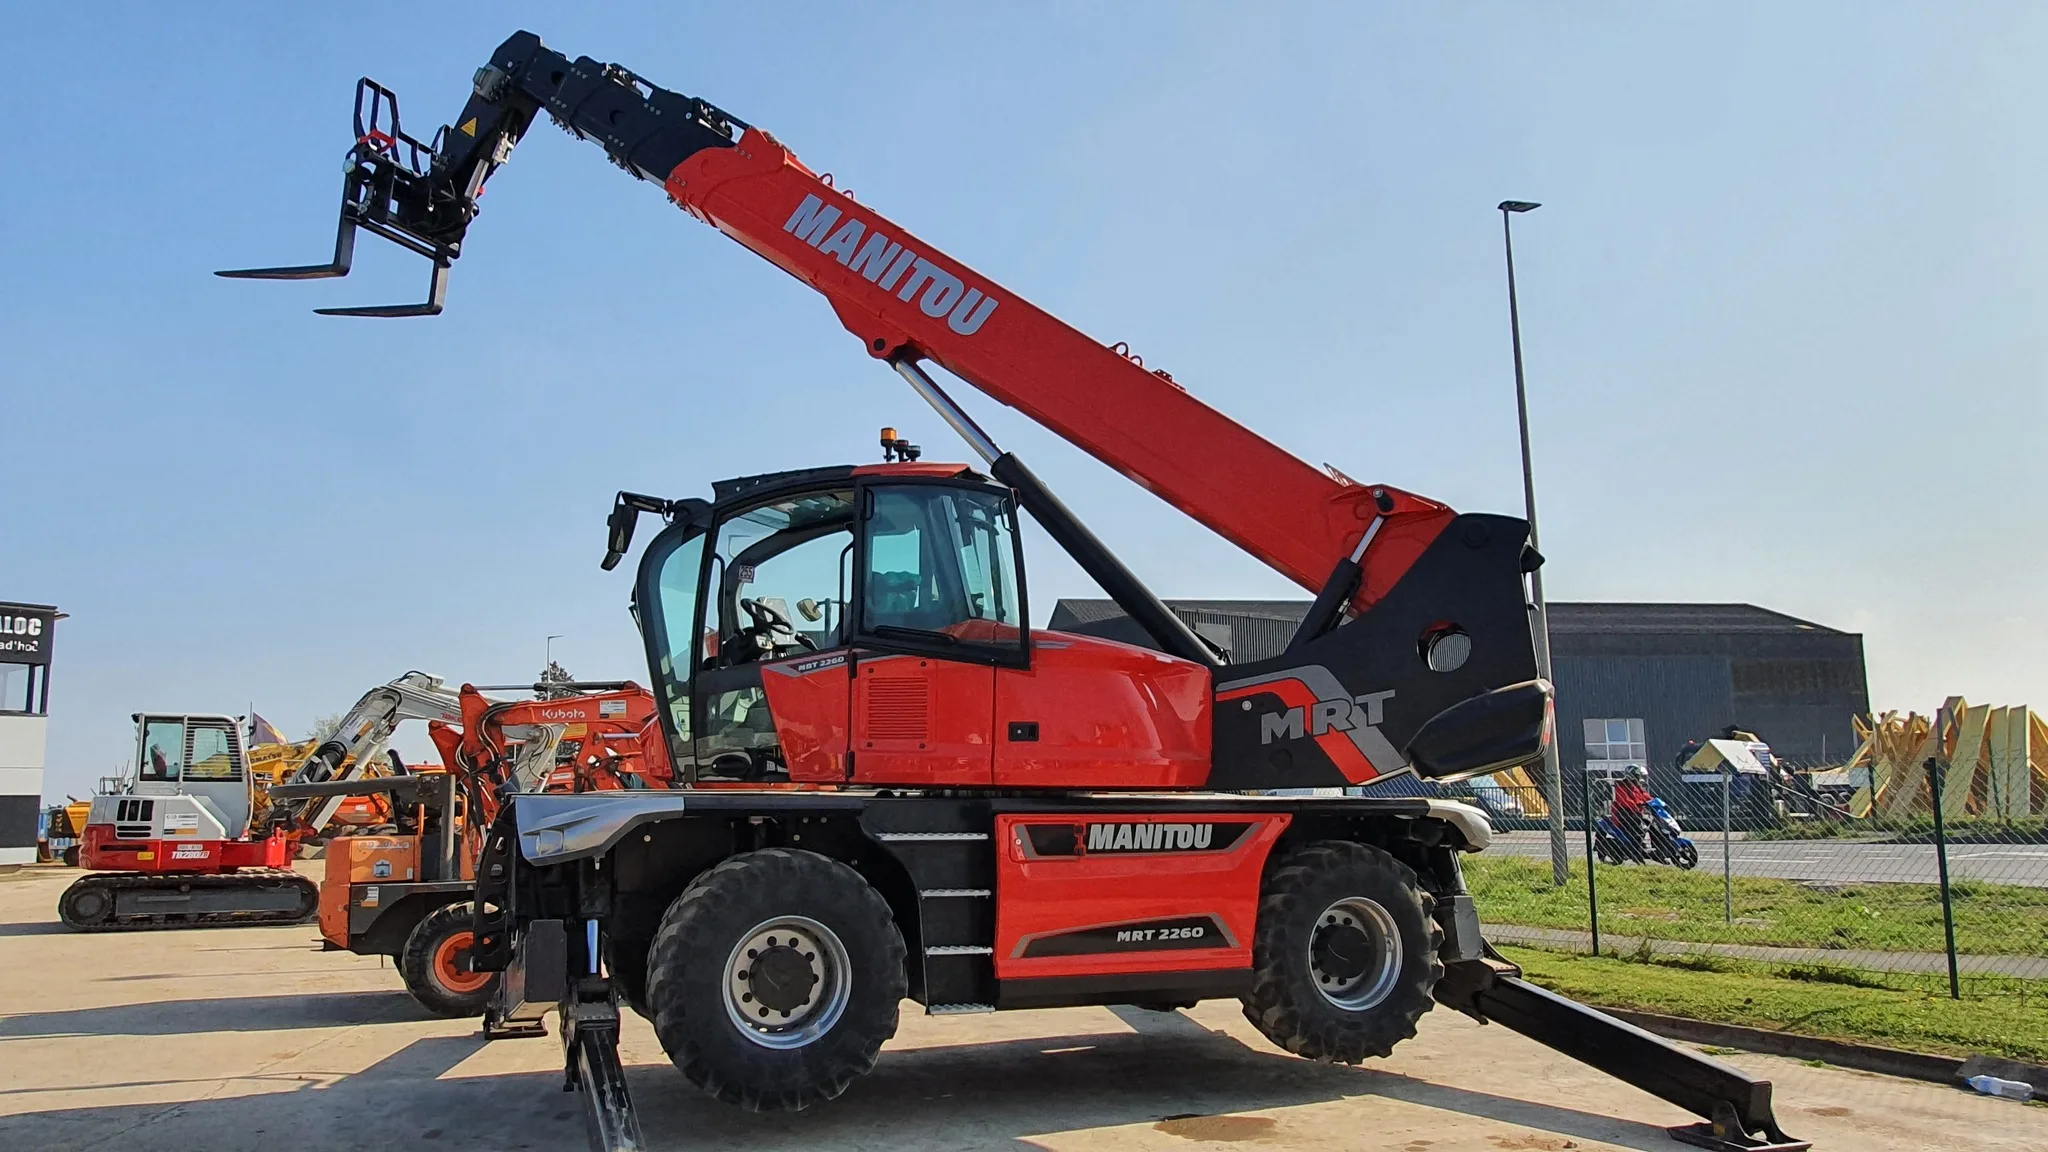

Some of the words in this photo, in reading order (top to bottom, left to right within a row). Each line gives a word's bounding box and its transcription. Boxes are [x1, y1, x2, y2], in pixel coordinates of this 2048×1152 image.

[782, 192, 999, 336] MANITOU
[0, 615, 42, 636] LOC
[798, 661, 818, 671] MRT
[820, 656, 845, 668] 2260
[541, 708, 586, 719] Kubota
[1261, 689, 1396, 745] MRT
[1088, 823, 1213, 850] MANITOU
[1116, 929, 1156, 943] MRT
[1158, 926, 1204, 939] 2260
